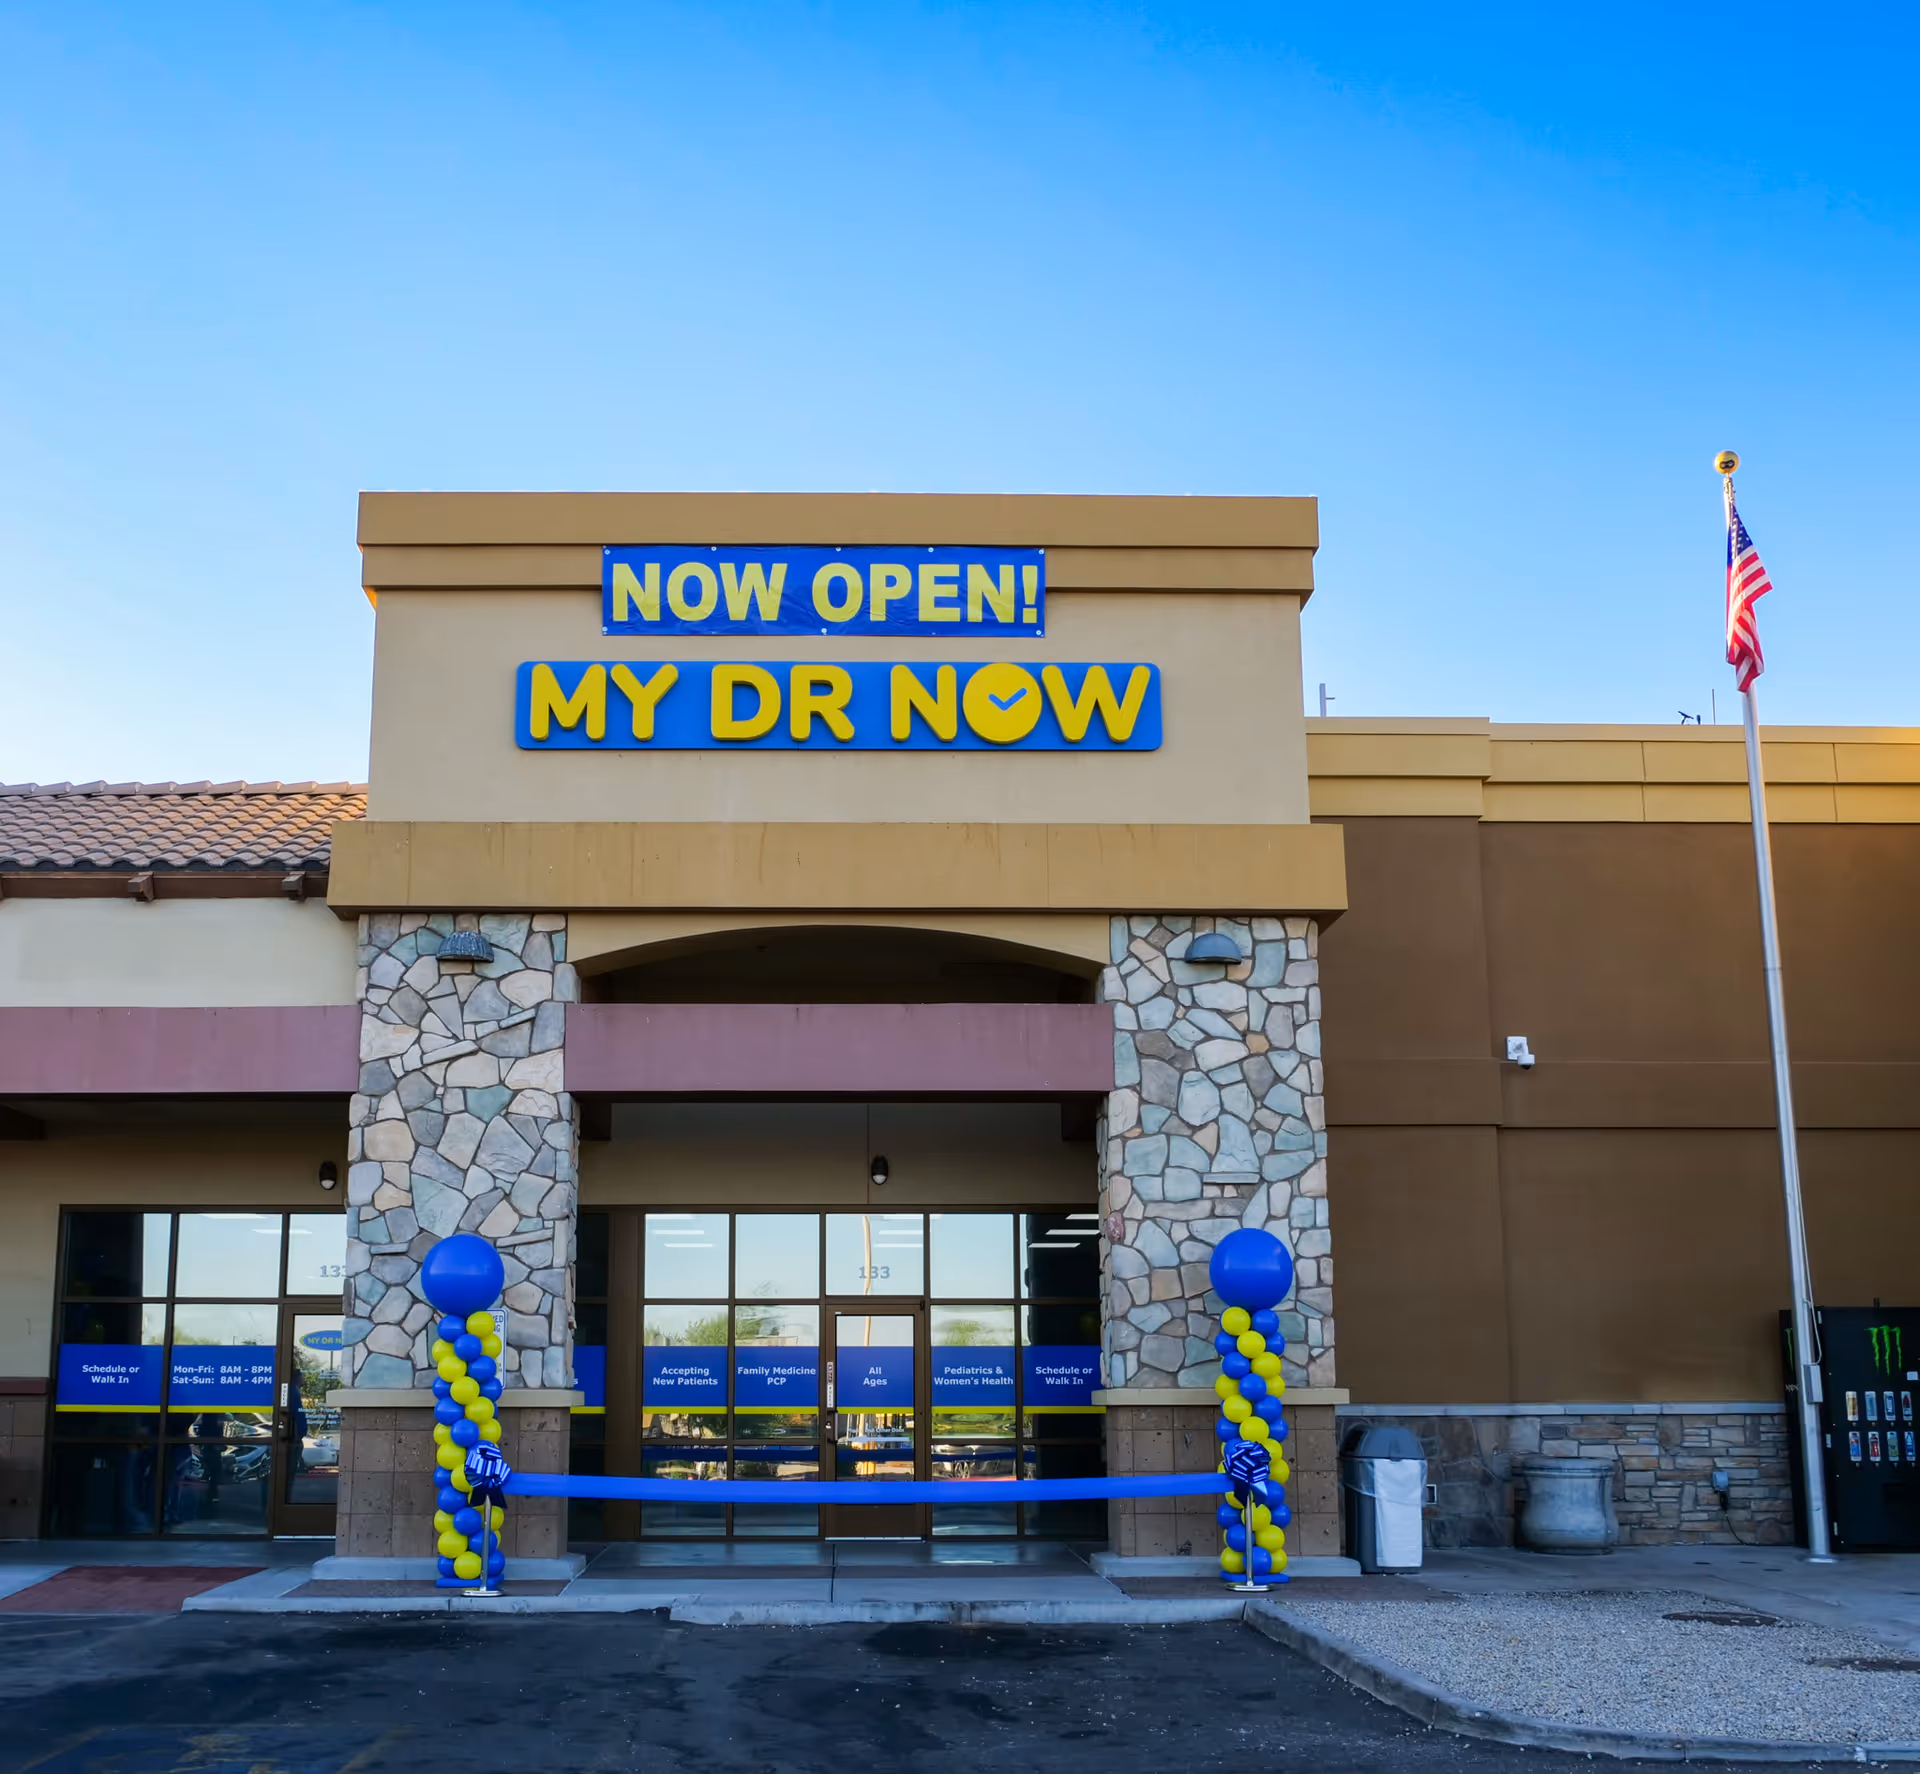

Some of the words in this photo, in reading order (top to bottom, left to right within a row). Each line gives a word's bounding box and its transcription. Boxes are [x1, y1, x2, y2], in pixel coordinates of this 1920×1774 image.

[612, 562, 788, 623] NOW
[811, 562, 1039, 624] OPEN!
[529, 663, 679, 742] MY
[710, 663, 855, 742] DR
[890, 661, 1151, 745] NOW
[859, 1266, 890, 1279] 133
[82, 1364, 127, 1373] Schedule
[173, 1365, 215, 1373] Mon-Fri:
[220, 1365, 241, 1374] 8AM
[251, 1365, 272, 1374] 8PM
[661, 1366, 710, 1376] Accepting
[737, 1366, 770, 1376] Family
[772, 1366, 816, 1375] Medicine
[868, 1366, 882, 1375] All
[944, 1366, 993, 1375] Pediatrics
[995, 1366, 1003, 1375] &
[1035, 1366, 1080, 1375] Schedule
[91, 1375, 115, 1383] Walk
[118, 1375, 129, 1384] In
[172, 1376, 215, 1384] Sat-Sun:
[220, 1376, 241, 1384] 8AM
[251, 1376, 272, 1384] 4PM
[653, 1377, 675, 1385] New
[677, 1377, 718, 1385] Patients
[767, 1377, 787, 1385] PCP
[863, 1377, 888, 1387] Ages
[934, 1377, 980, 1385] Women's
[981, 1377, 1014, 1385] Health
[1045, 1377, 1070, 1385] Walk
[1072, 1377, 1084, 1385] In
